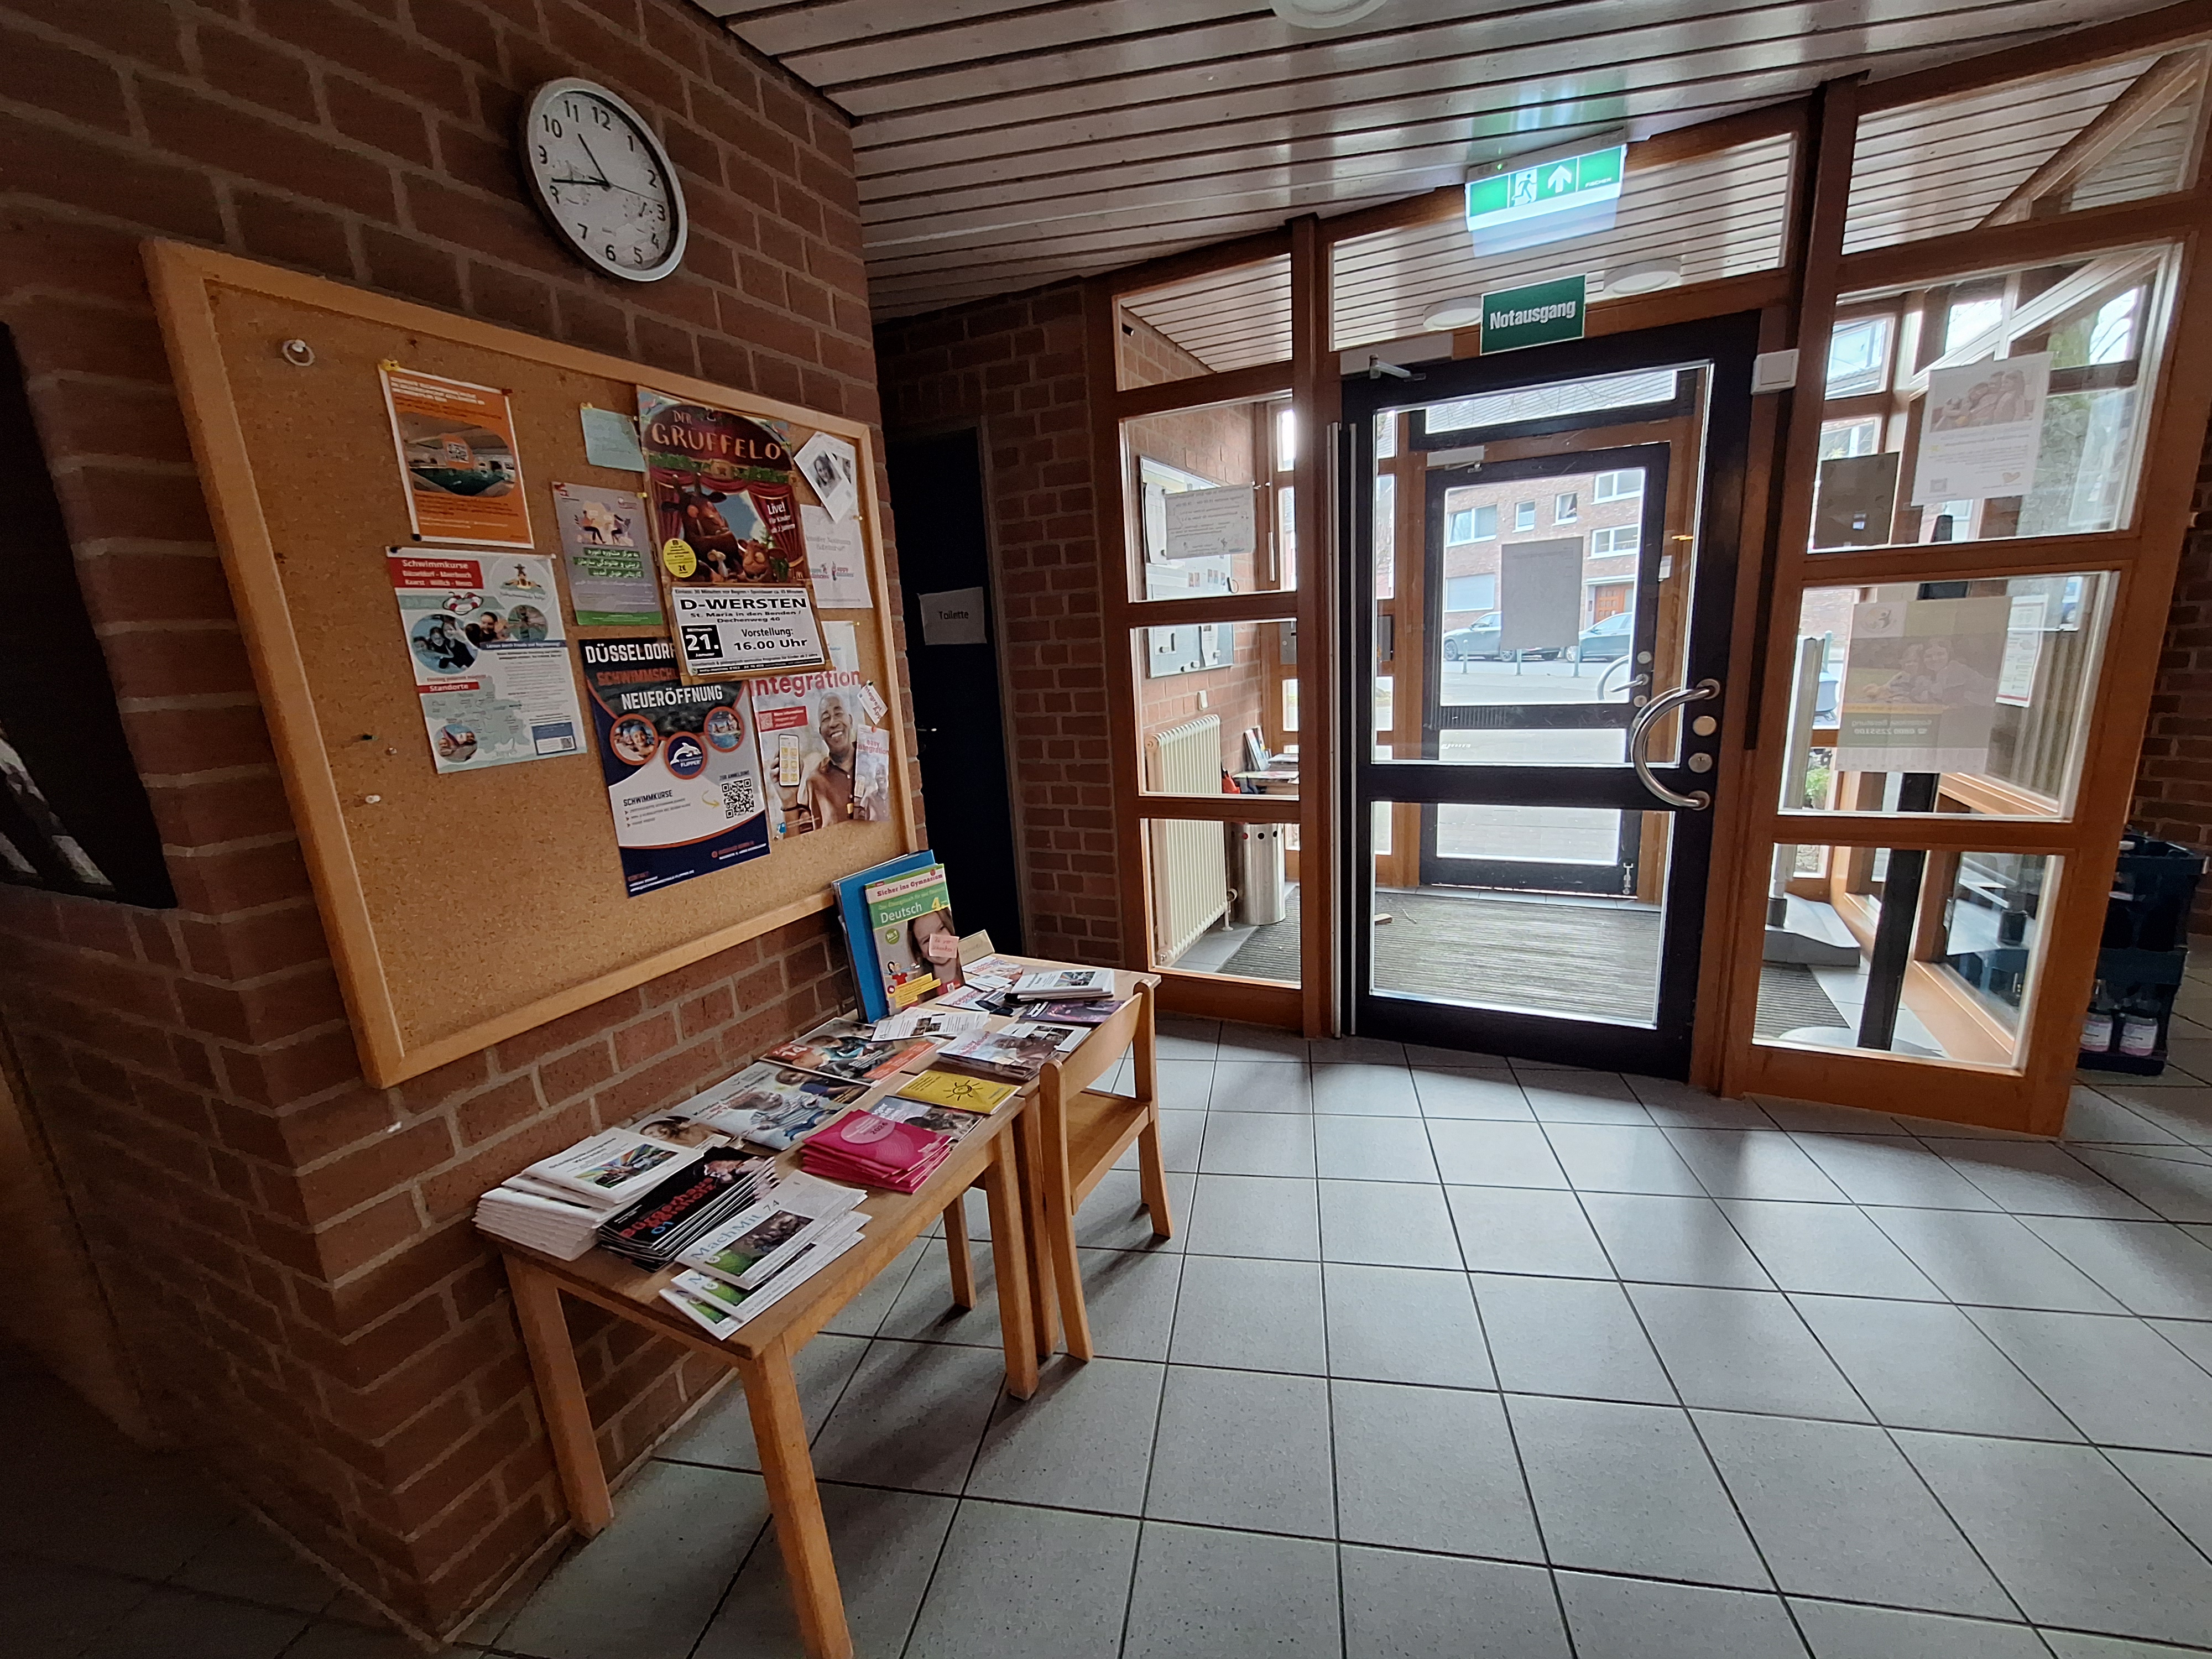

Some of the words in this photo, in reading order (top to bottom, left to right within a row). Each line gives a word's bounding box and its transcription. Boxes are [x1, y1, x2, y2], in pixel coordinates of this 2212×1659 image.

[564, 101, 579, 123] 11
[593, 107, 611, 131] 12
[542, 114, 562, 138] 10
[628, 135, 633, 152] 1
[648, 170, 657, 188] 2
[658, 204, 666, 221] 3
[577, 223, 587, 240] 7
[652, 233, 659, 249] 4
[606, 245, 616, 262] 6
[634, 247, 643, 264] 5
[1490, 300, 1575, 330] Notausgang
[672, 410, 692, 424] DER
[767, 501, 786, 515] Live!
[402, 560, 468, 569] Schwimmkurse
[680, 598, 807, 610] D-WERSTEN
[939, 611, 969, 619] Toilette
[741, 628, 794, 637] Vorstellung:
[685, 634, 719, 651] 21.
[734, 640, 775, 651] 16.00
[779, 638, 807, 648] Uhr
[585, 643, 676, 663] DÜSSELDORF
[429, 683, 468, 692] Standorte
[622, 685, 723, 710] NEUERÖFFNUNG
[867, 739, 880, 748] easy
[623, 790, 673, 806] SCHWIMMKURSE
[877, 886, 899, 896] Sicher
[910, 874, 943, 888] Gymnasium
[880, 902, 922, 924] Deutsch
[870, 1122, 888, 1135] 2026
